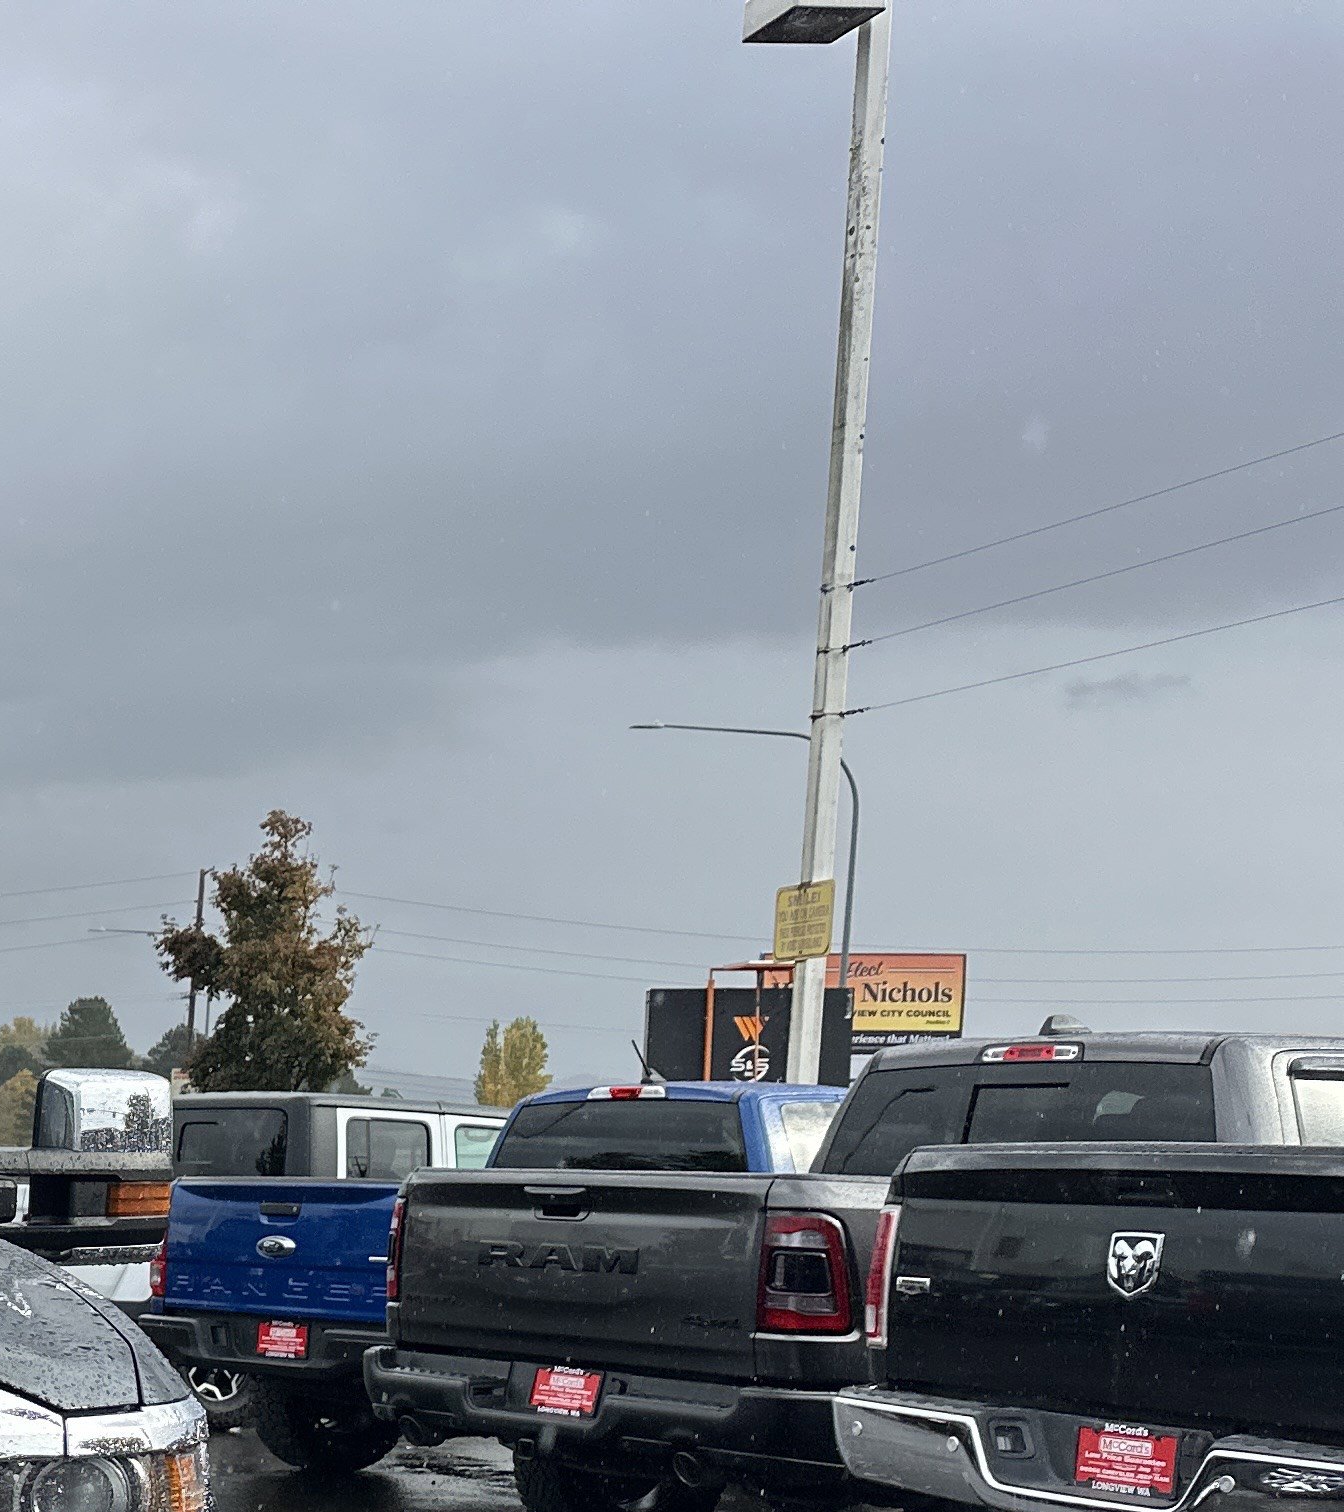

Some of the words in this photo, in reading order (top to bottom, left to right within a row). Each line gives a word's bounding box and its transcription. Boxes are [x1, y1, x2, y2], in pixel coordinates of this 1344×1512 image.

[847, 962, 883, 979] Elect
[861, 980, 953, 1004] Nichols
[880, 1009, 904, 1018] CITY
[906, 1009, 952, 1018] COUNCIL
[477, 1239, 640, 1275] RAM
[1104, 1422, 1149, 1437] McCord's
[1102, 1438, 1150, 1455] McCord's
